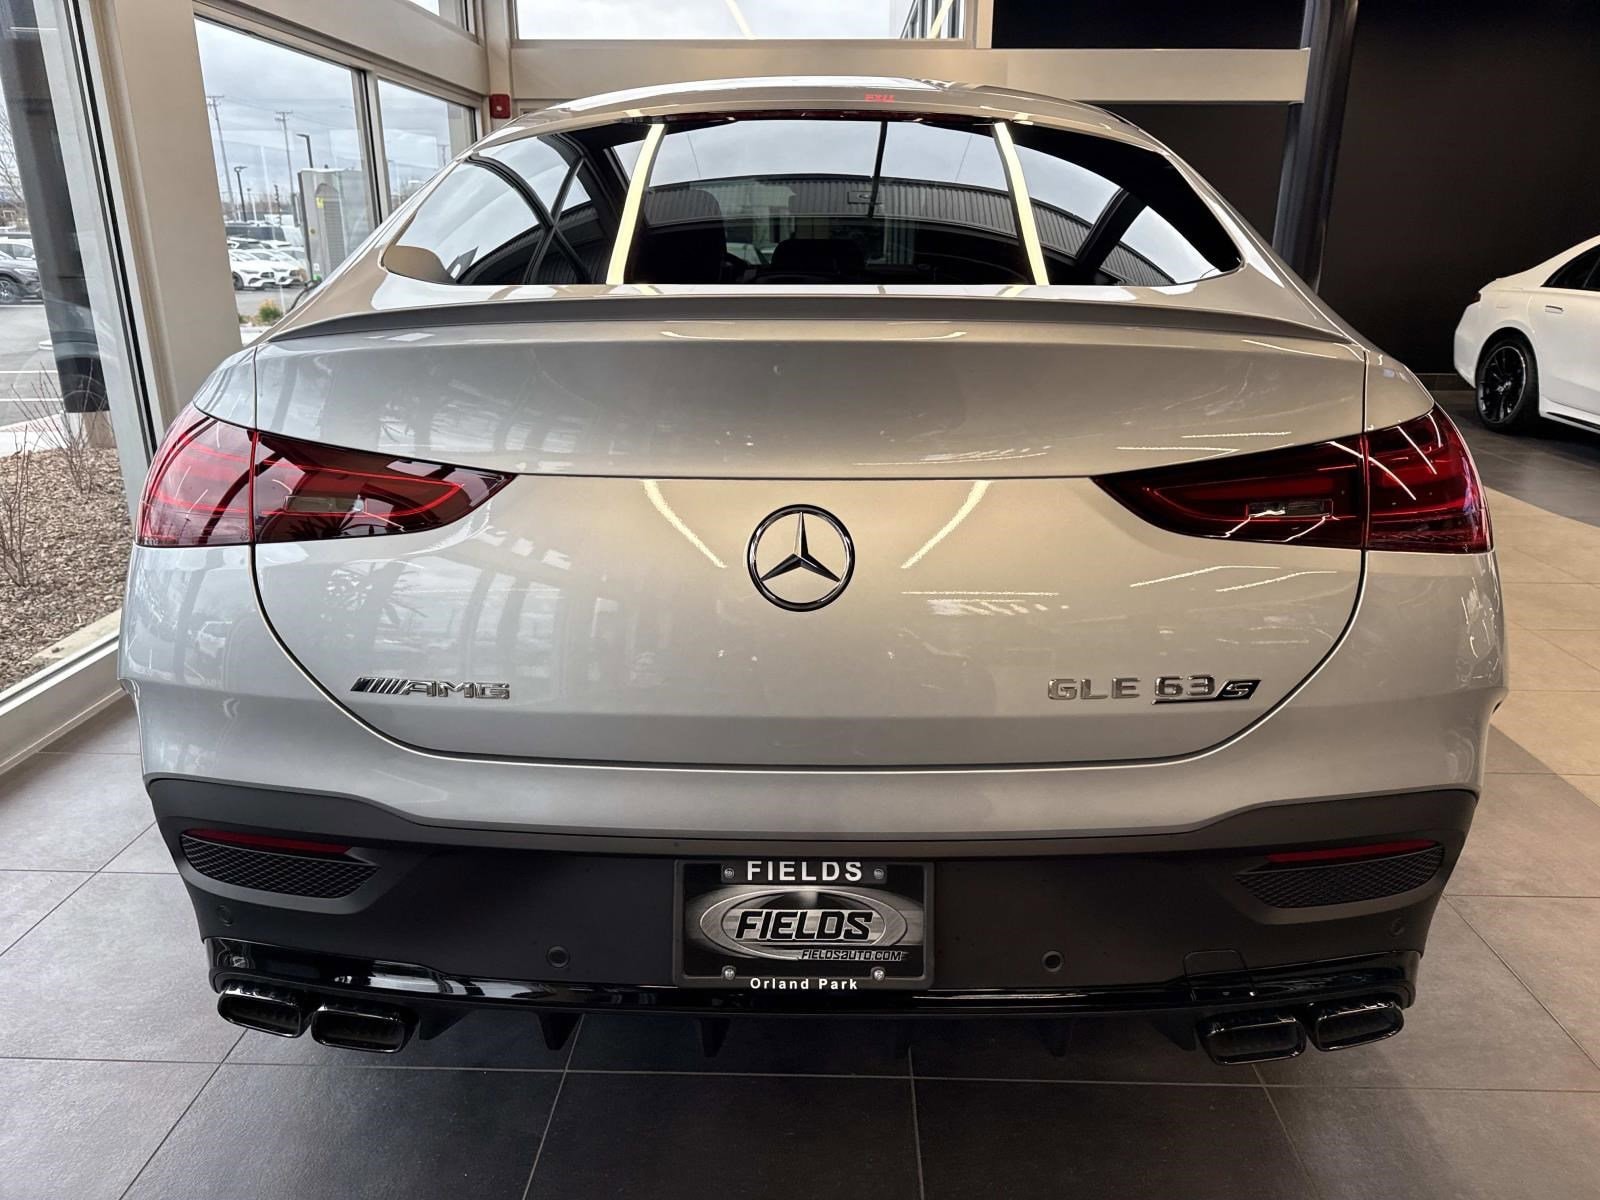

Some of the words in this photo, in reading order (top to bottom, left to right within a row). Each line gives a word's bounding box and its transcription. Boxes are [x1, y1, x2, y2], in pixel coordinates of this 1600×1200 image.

[400, 679, 510, 699] AMG
[1047, 677, 1141, 700] GLE
[747, 861, 863, 882] FIELDS
[735, 910, 874, 942] FIELDS
[750, 977, 809, 990] Orland
[818, 977, 858, 990] Park
